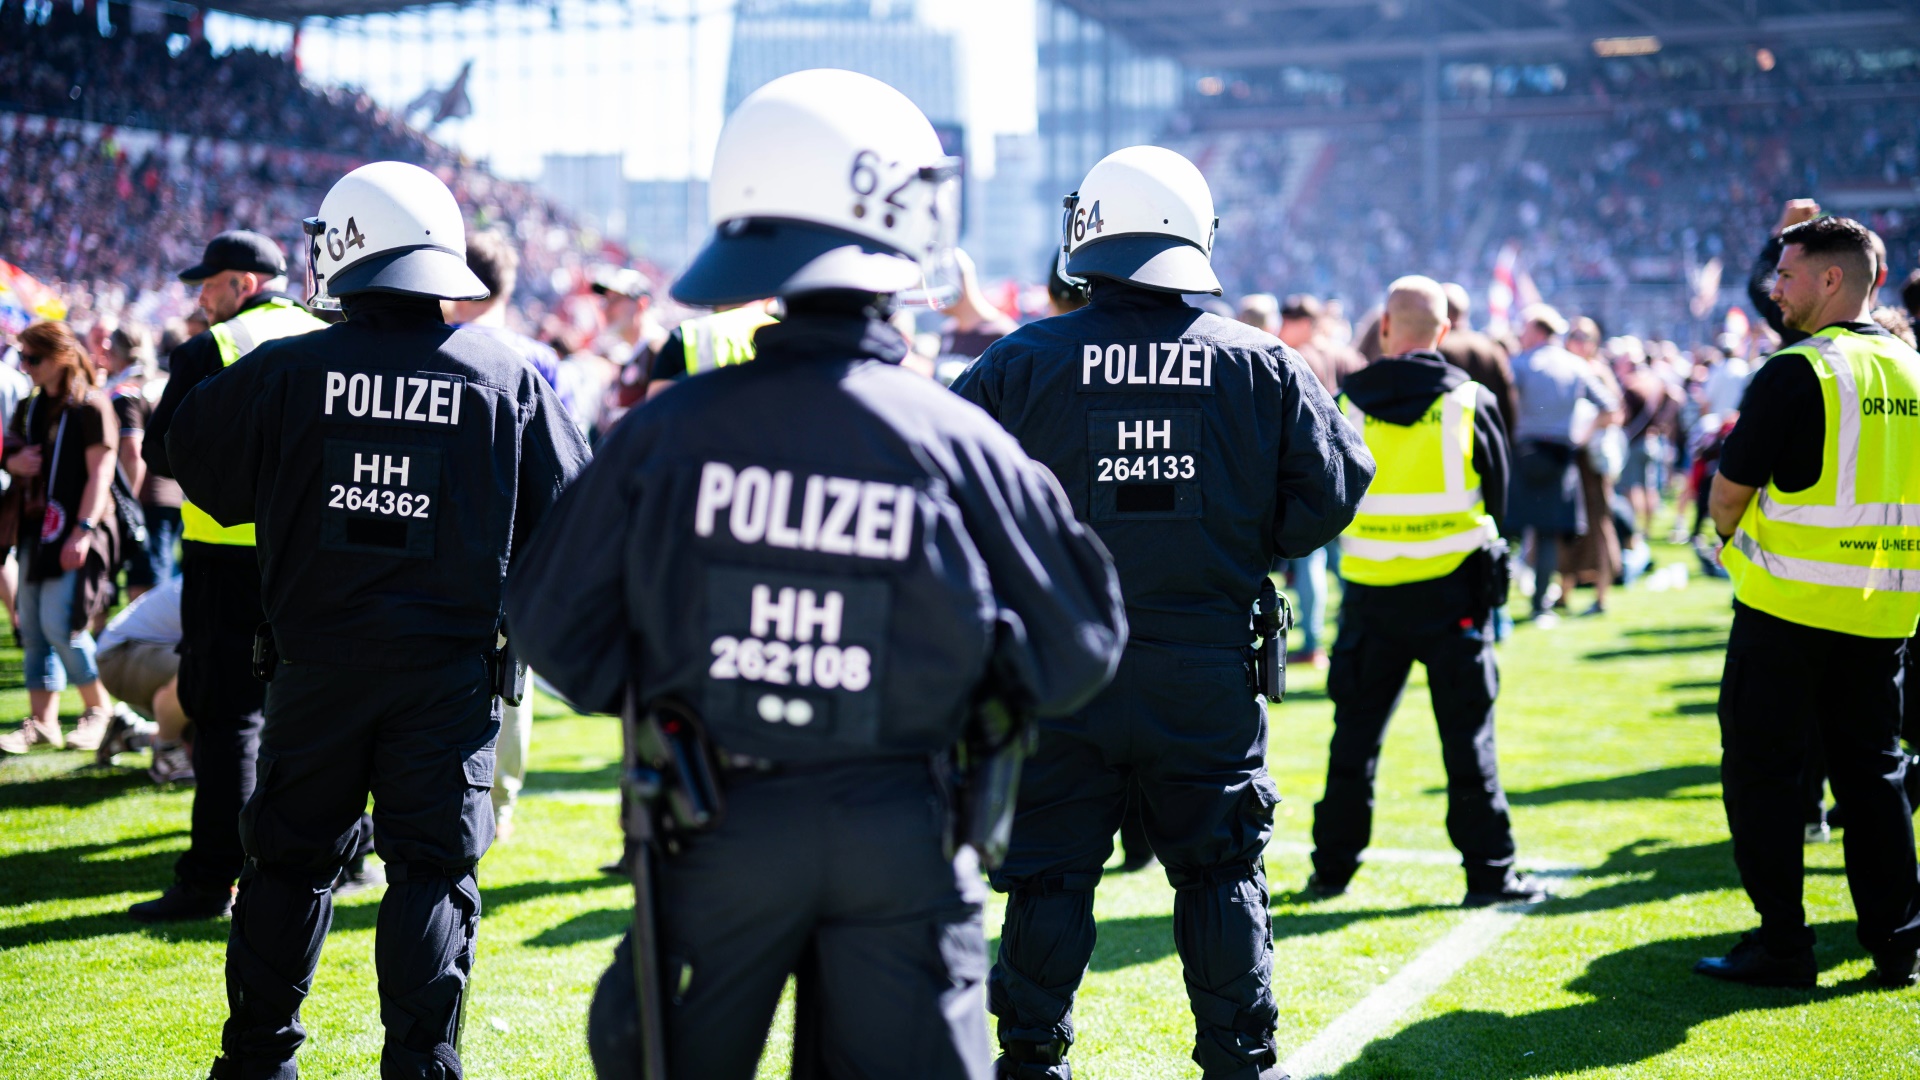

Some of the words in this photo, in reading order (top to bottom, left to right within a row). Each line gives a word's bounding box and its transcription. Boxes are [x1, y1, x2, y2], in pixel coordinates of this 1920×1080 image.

[326, 215, 366, 262] 64
[1074, 199, 1104, 242] 64
[1082, 342, 1212, 387] POLIZEI
[324, 371, 462, 425] POLIZEI
[1118, 419, 1171, 450] HH
[353, 452, 410, 487] HH
[1097, 455, 1196, 482] 264133
[328, 484, 430, 519] 264362
[695, 461, 916, 561] POLIZEI
[750, 584, 844, 644] HH
[709, 635, 871, 692] 262108
